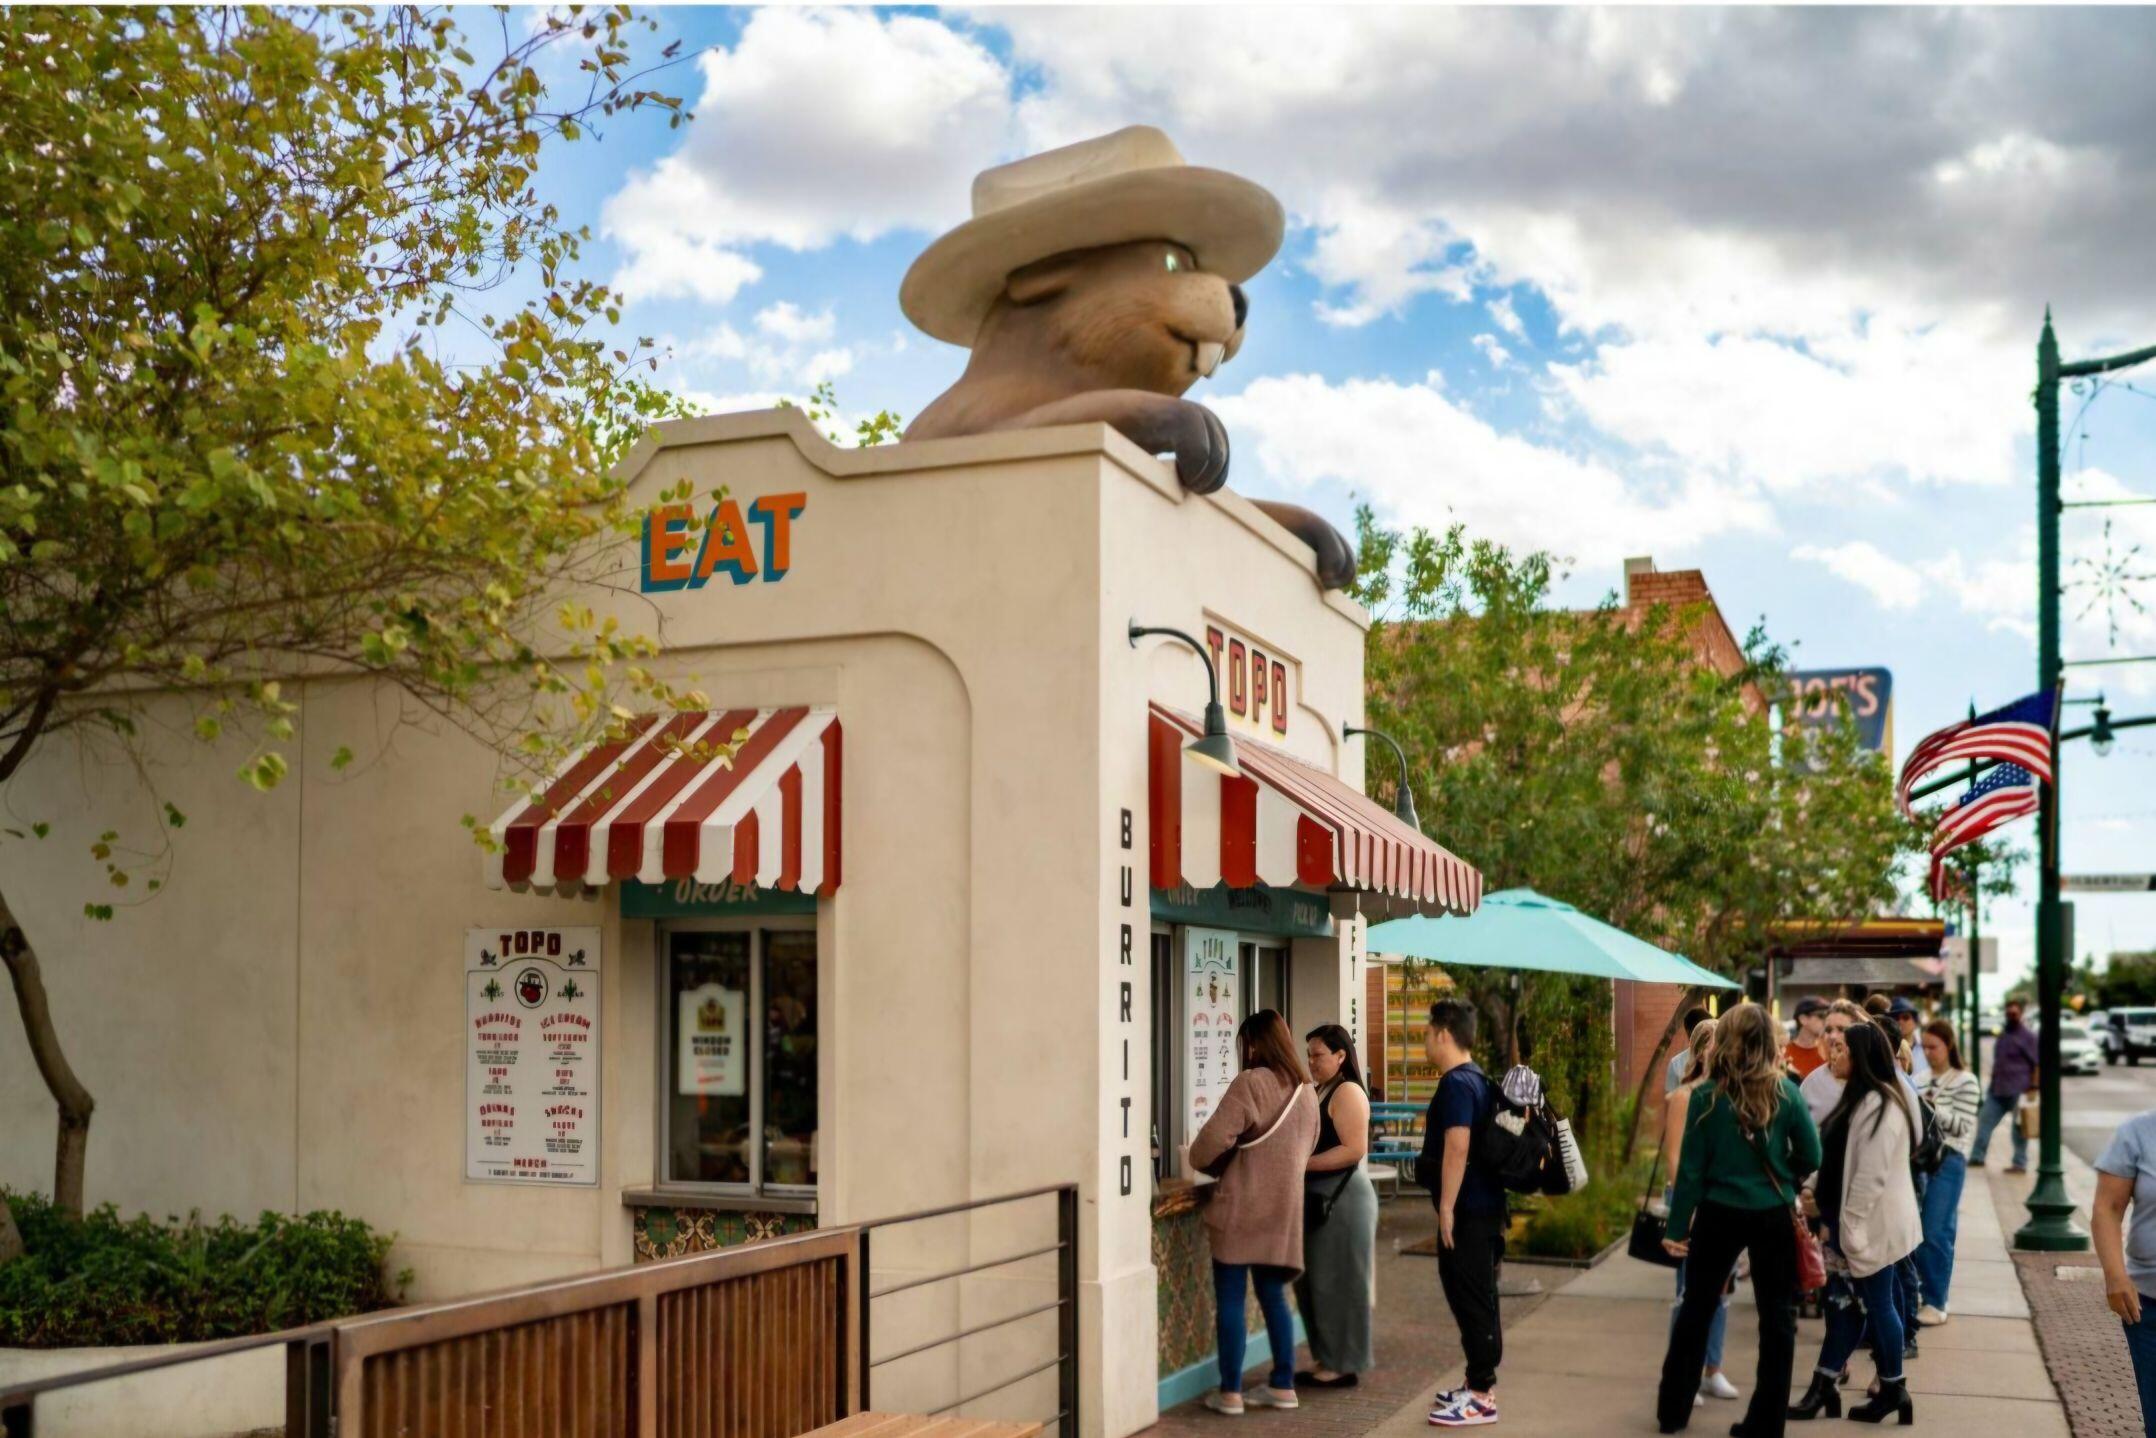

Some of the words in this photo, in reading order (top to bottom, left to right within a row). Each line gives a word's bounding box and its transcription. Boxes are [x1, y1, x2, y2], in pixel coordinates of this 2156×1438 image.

[641, 491, 807, 593] EAT
[1207, 625, 1287, 735] TOPO
[499, 931, 561, 957] TOPO
[1120, 808, 1133, 1197] BURRITO
